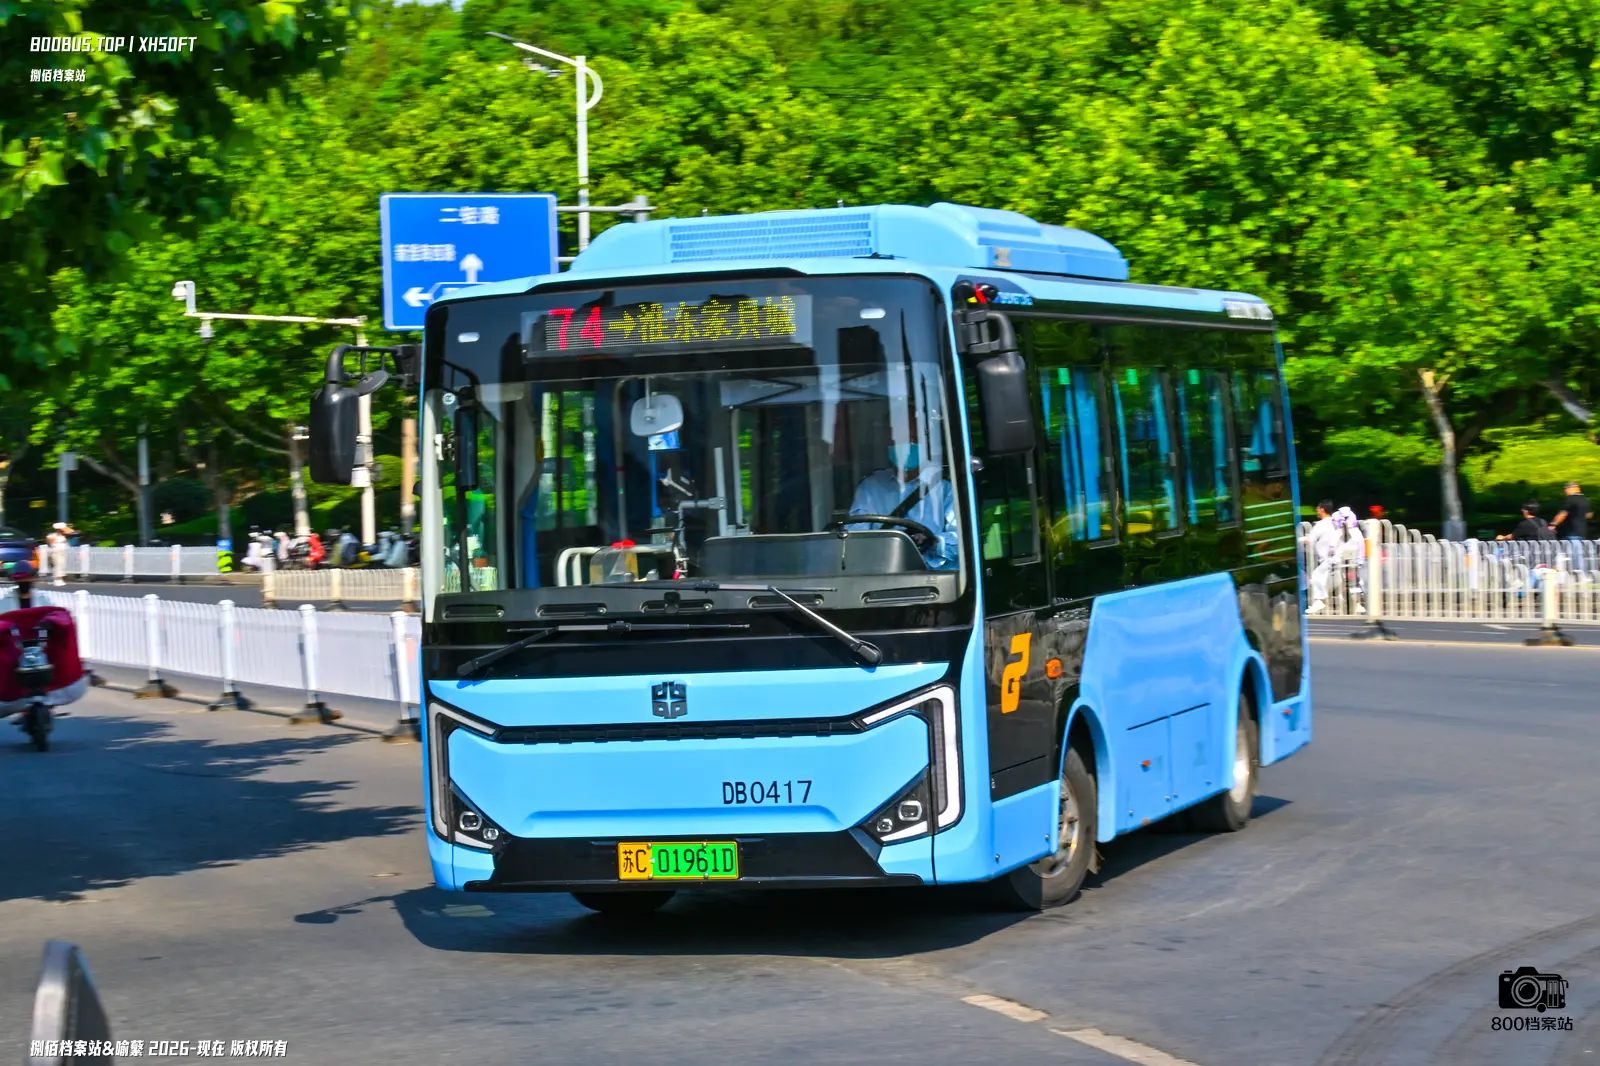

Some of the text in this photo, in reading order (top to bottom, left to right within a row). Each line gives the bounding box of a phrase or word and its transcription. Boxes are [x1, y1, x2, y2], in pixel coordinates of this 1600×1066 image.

[549, 306, 605, 350] 74
[722, 780, 812, 805] DB0417
[658, 848, 734, 873] 01961D
